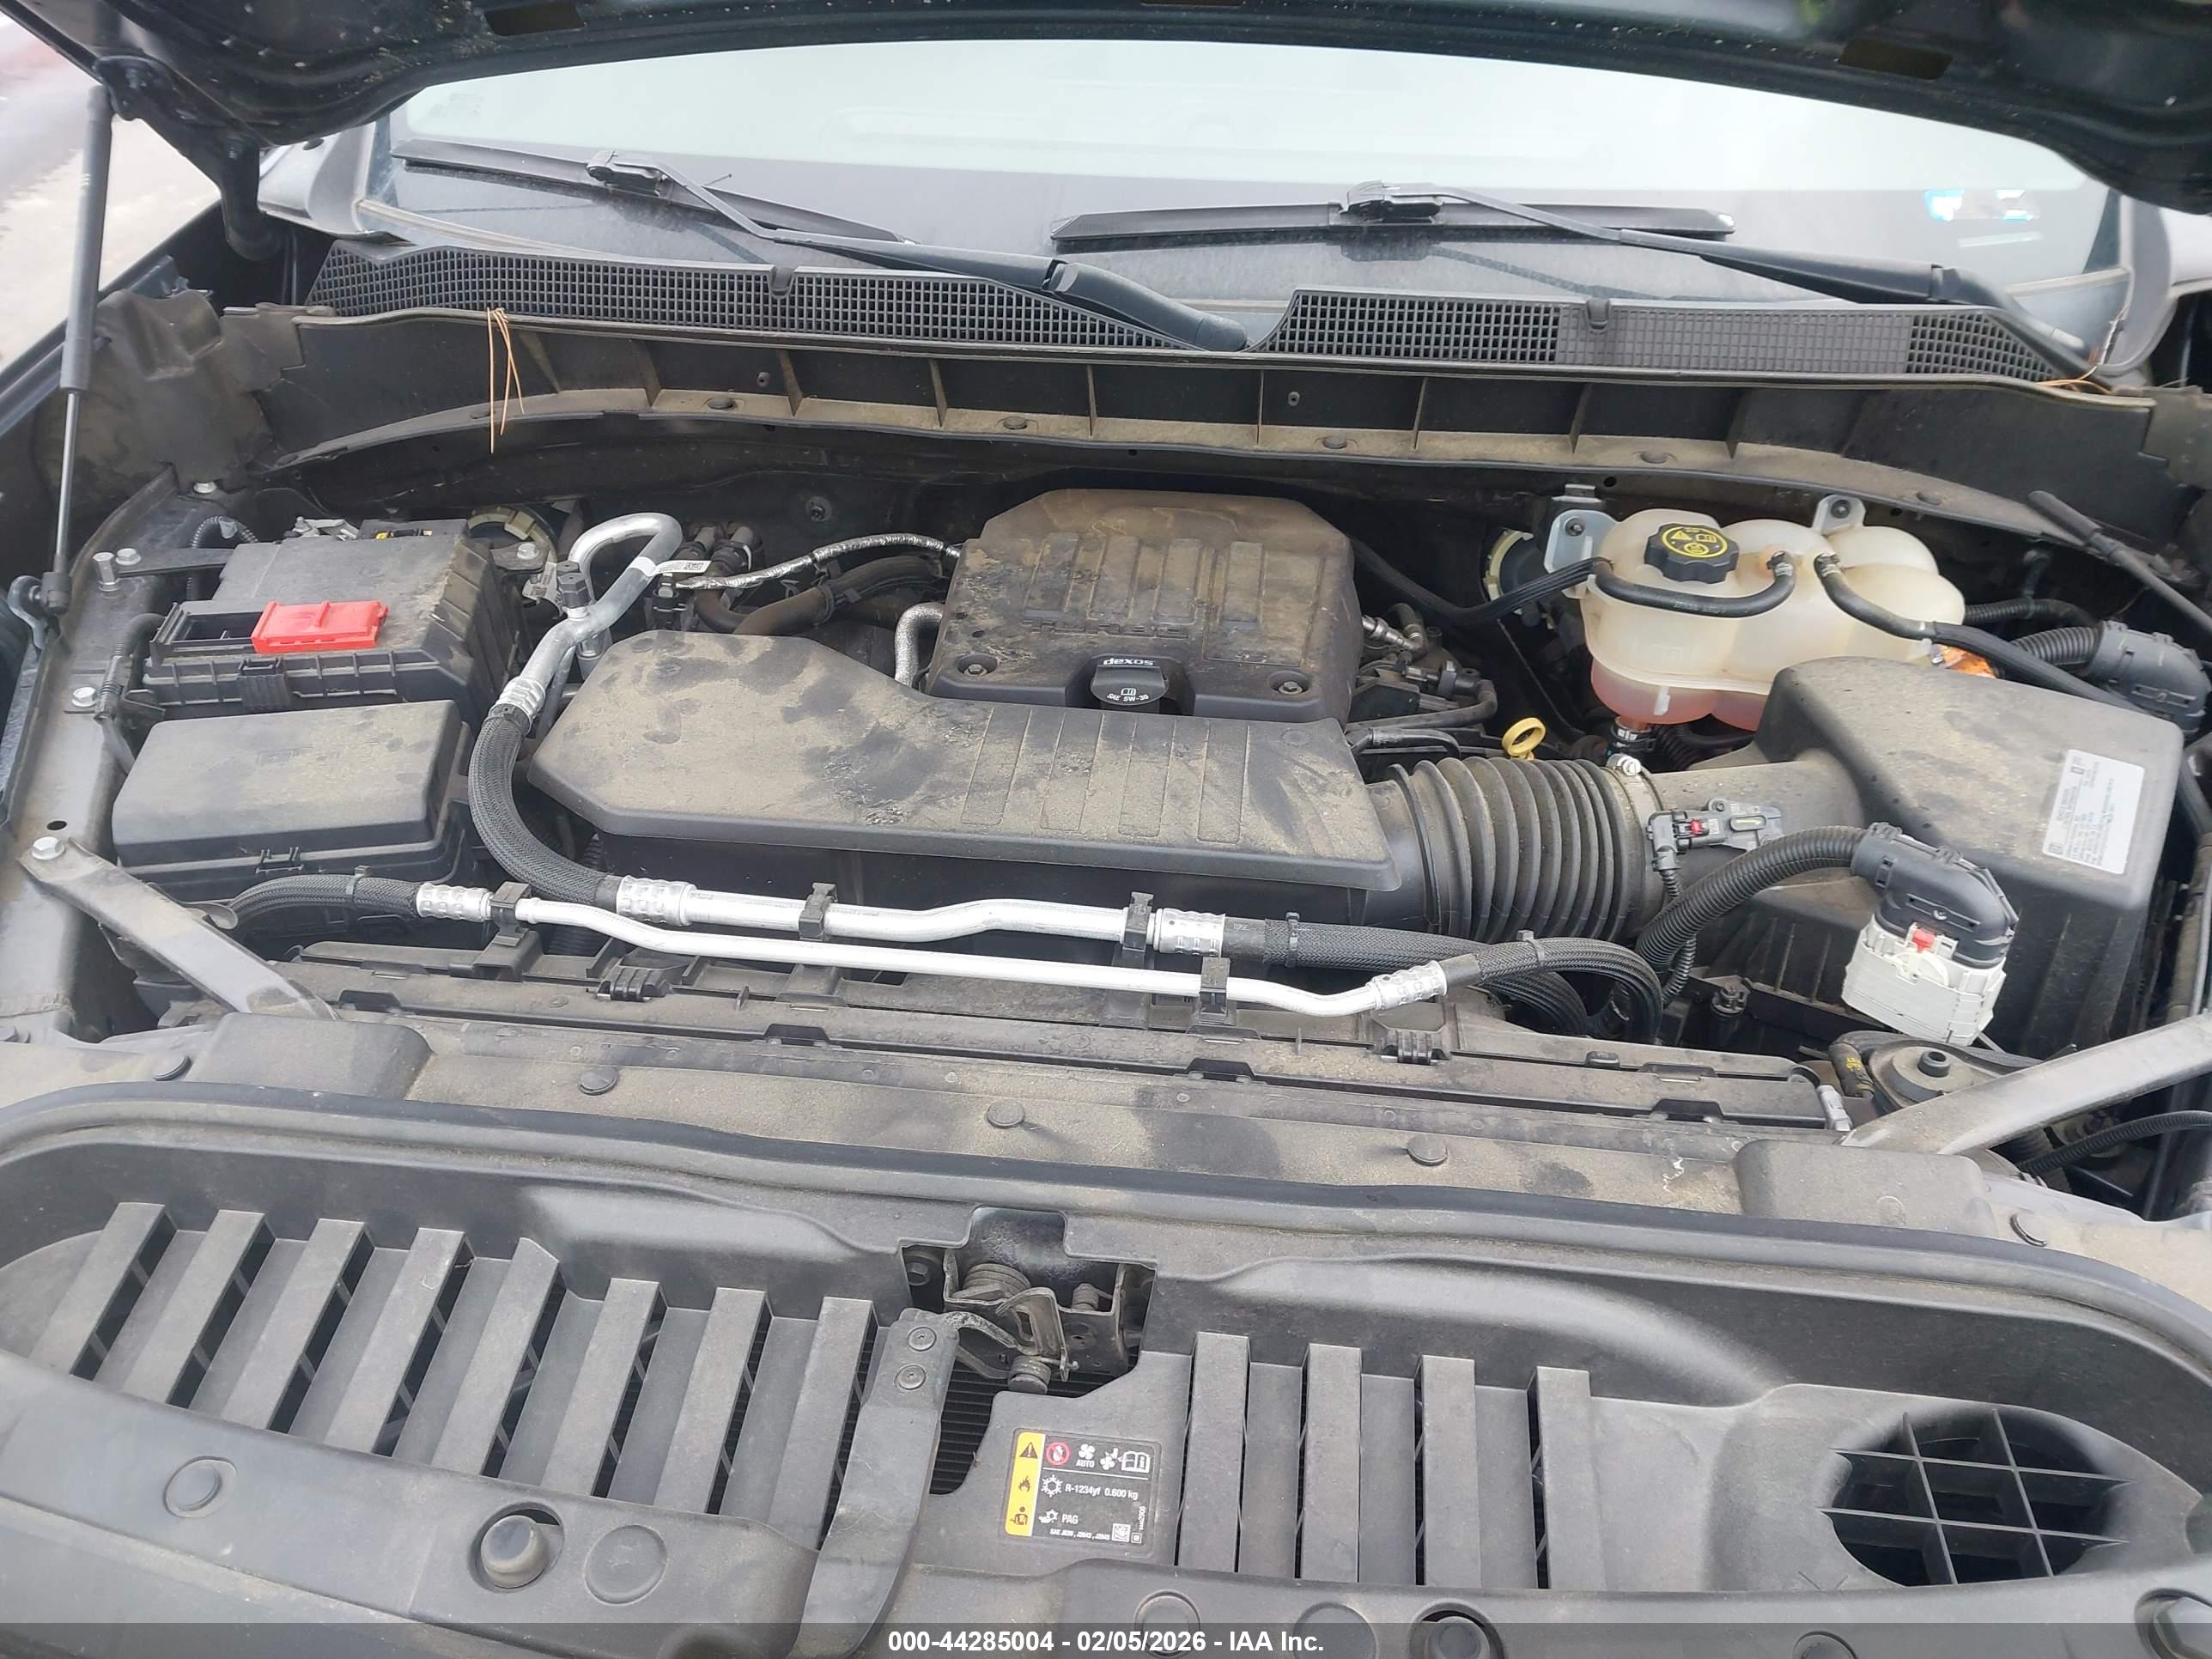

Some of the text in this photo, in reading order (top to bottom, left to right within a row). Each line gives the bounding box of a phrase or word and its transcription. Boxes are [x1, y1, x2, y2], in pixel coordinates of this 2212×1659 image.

[1106, 693, 1121, 702] SAE
[1065, 1484, 1139, 1501] R-1234yf 0.600 kg
[1061, 1514, 1079, 1524] PAG
